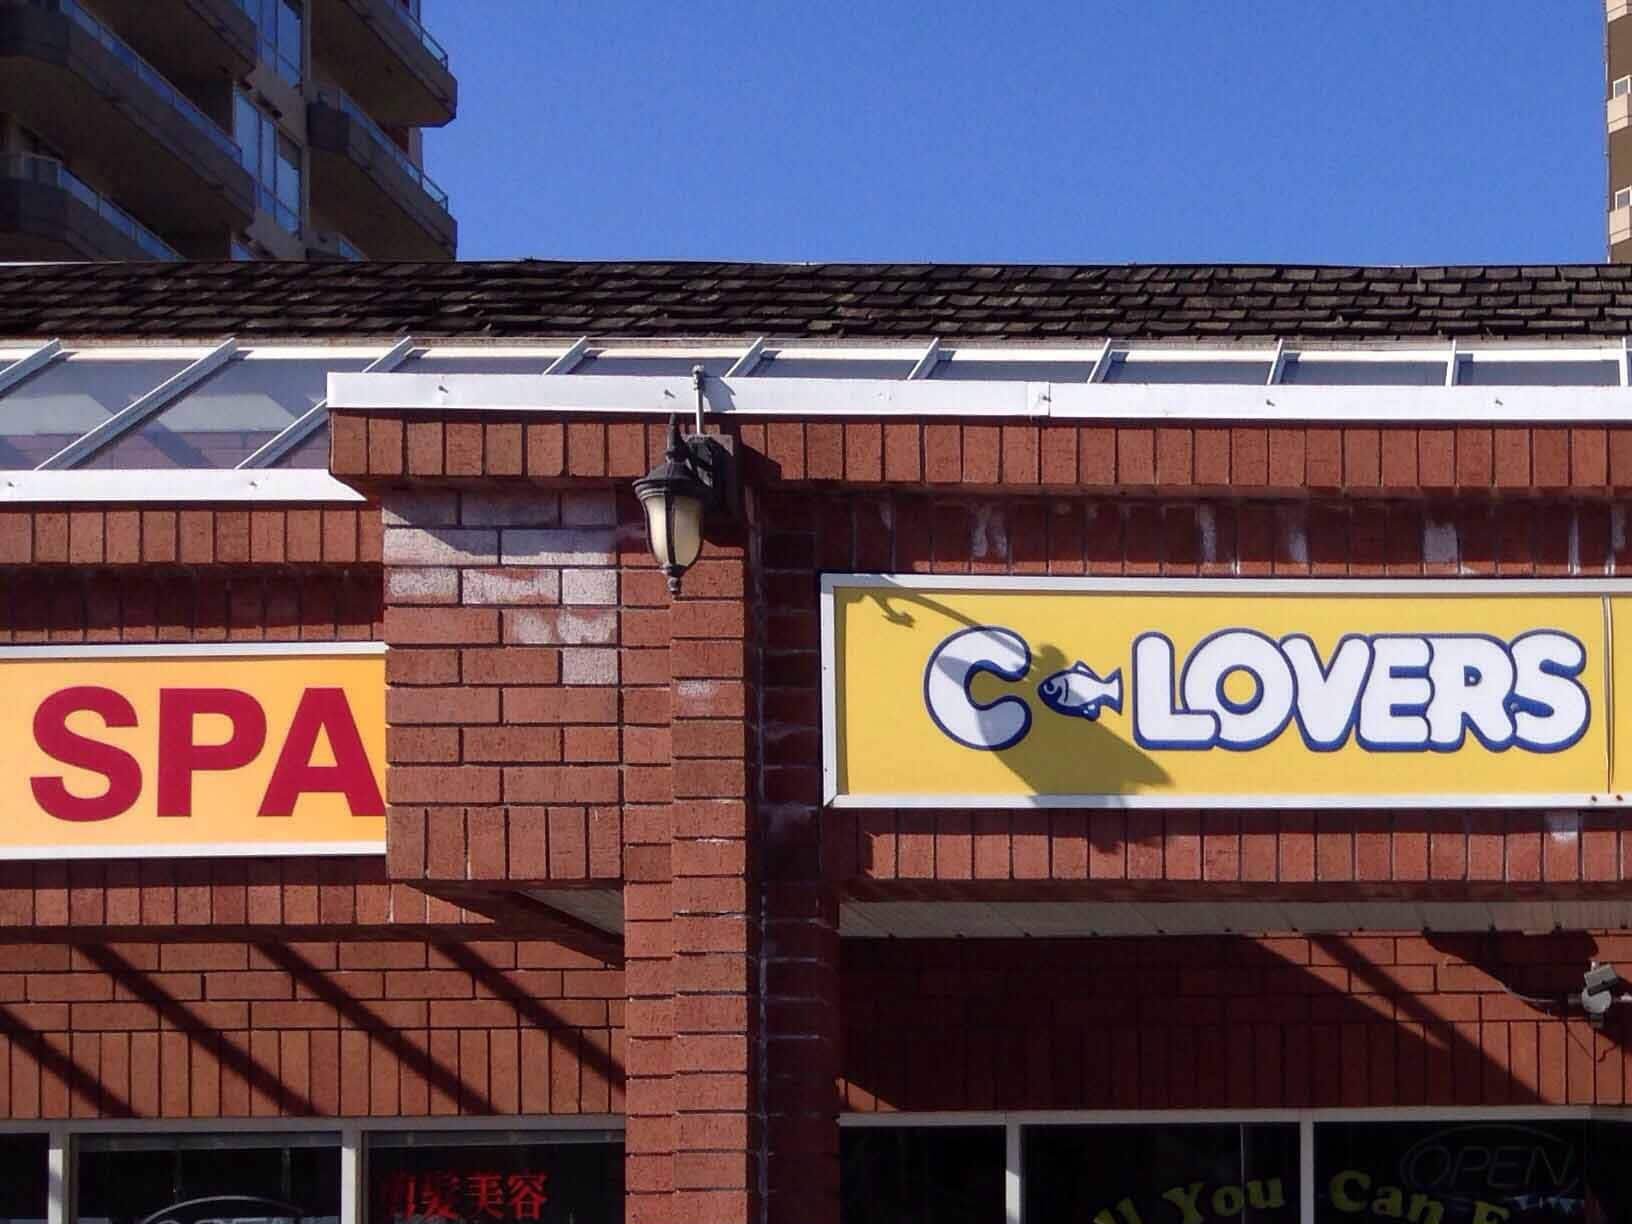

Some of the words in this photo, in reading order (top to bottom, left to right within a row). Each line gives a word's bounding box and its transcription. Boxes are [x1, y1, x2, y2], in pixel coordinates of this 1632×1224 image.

[1133, 627, 1592, 753] LOVERS
[30, 685, 386, 823] SPA
[1409, 1143, 1576, 1190] OPEN
